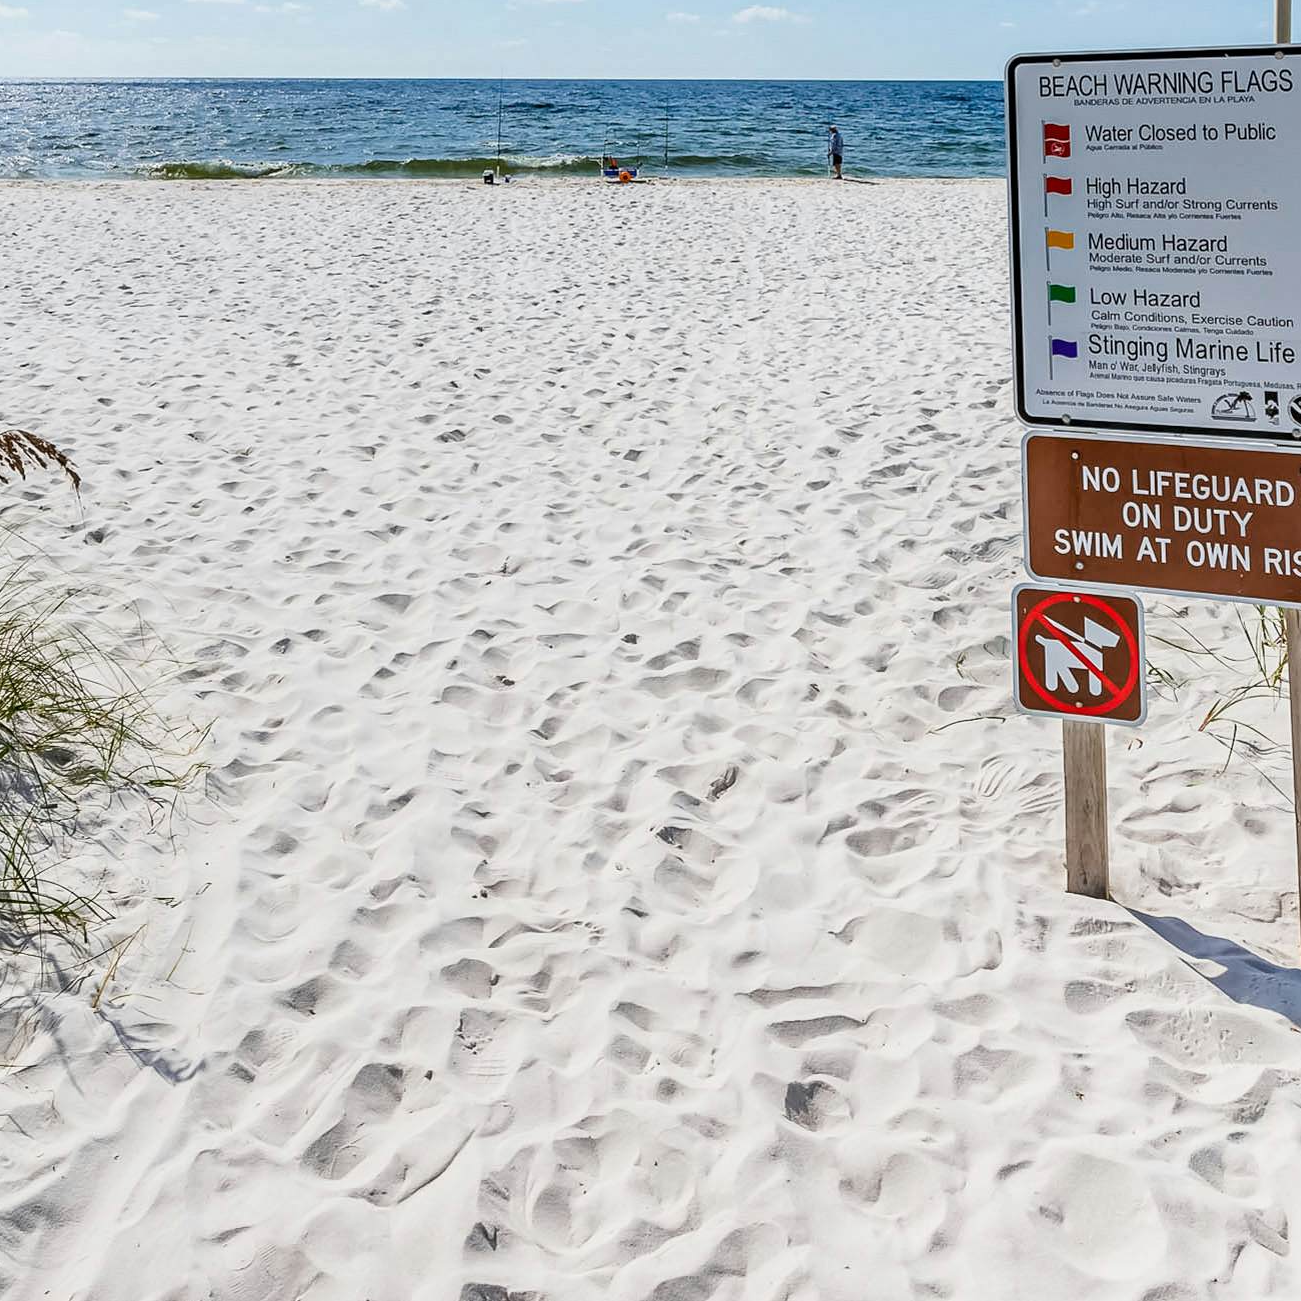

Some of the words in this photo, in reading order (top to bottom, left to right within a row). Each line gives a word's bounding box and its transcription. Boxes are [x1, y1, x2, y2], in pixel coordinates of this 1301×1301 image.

[1039, 74, 1107, 97] BEACH
[1114, 71, 1213, 95] WARNING
[1221, 69, 1293, 93] FLAGS
[1074, 98, 1120, 106] BANDERAS
[1136, 96, 1196, 105] ADVERTENCIA
[1199, 96, 1211, 104] EN
[1227, 95, 1255, 103] PLAYA
[1085, 125, 1133, 141] Water
[1139, 124, 1196, 141] Closed
[1203, 124, 1218, 140] to
[1225, 122, 1276, 140] Public
[1086, 177, 1121, 198] High
[1127, 177, 1186, 195] Hazard
[1087, 199, 1112, 211] High
[1116, 198, 1139, 209] Surf
[1142, 199, 1179, 210] and/or
[1182, 199, 1222, 212] Strong
[1226, 199, 1278, 211] Currents
[1088, 232, 1155, 251] Medium
[1162, 234, 1227, 252] Hazard
[1089, 252, 1142, 263] Moderate
[1146, 253, 1170, 264] Surf
[1173, 254, 1211, 265] and/or
[1215, 255, 1267, 266] Currents
[1091, 287, 1127, 305] Low
[1133, 289, 1200, 308] Hazard
[1091, 310, 1120, 320] Calm
[1124, 311, 1188, 324] Conditions,
[1191, 313, 1243, 326] Exercise
[1247, 315, 1294, 328] Caution
[1203, 327, 1224, 335] Tenga
[1088, 334, 1168, 362] Stinging
[1176, 338, 1248, 361] Marine
[1256, 341, 1295, 363] Life
[1089, 360, 1108, 370] Man
[1120, 362, 1139, 372] War,
[1142, 363, 1180, 375] Jellyfish,
[1183, 364, 1226, 378] Stingrays
[1082, 465, 1120, 493] NO
[1132, 469, 1295, 507] LIFEGUARD
[1122, 502, 1161, 530] ON
[1173, 506, 1253, 537] DUTY
[1054, 529, 1123, 560] SWIM
[1136, 537, 1172, 564] AT
[1186, 540, 1250, 571] OWN
